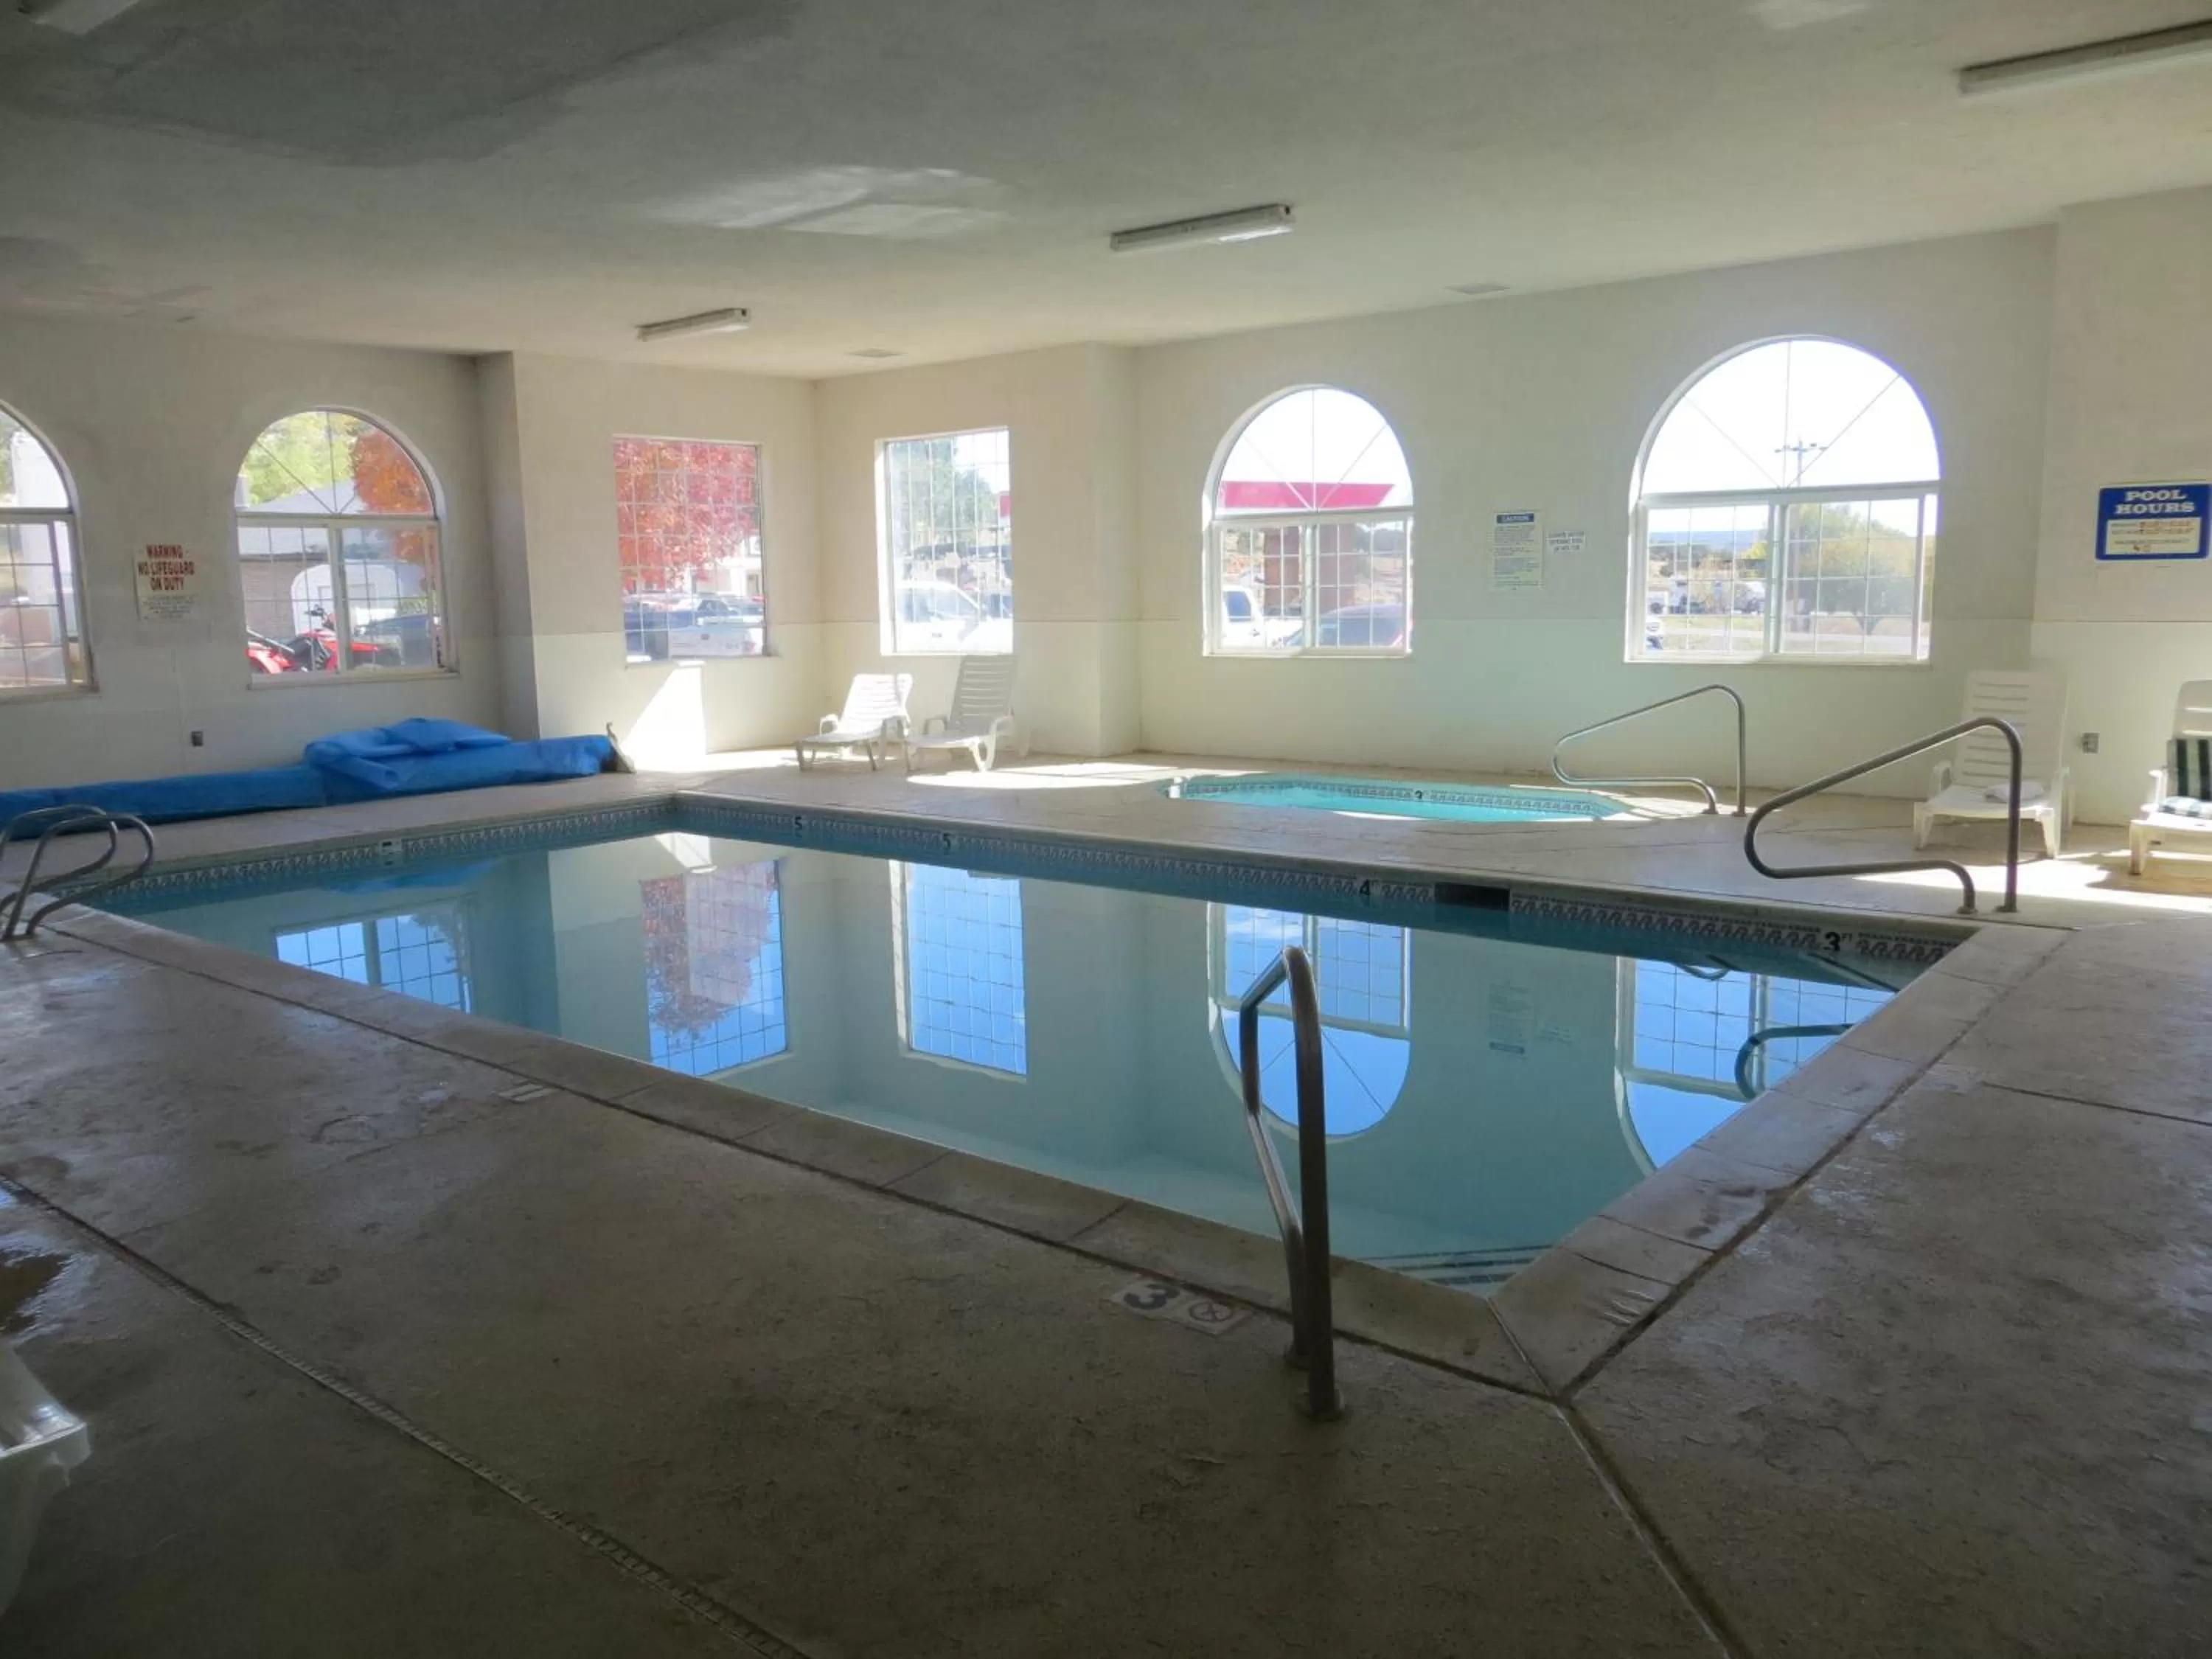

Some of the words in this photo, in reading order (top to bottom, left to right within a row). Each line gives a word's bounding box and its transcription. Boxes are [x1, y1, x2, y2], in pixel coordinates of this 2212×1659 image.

[2125, 490, 2186, 501] POOL
[2115, 501, 2194, 514] HOURS
[146, 544, 183, 559] WARNING
[138, 561, 149, 576] NO
[150, 561, 195, 575] LIFEGUARD
[150, 577, 162, 591] ON
[164, 577, 184, 591] DUTY
[794, 816, 803, 830] 5
[1359, 879, 1369, 895] 4
[1823, 931, 1840, 952] 3
